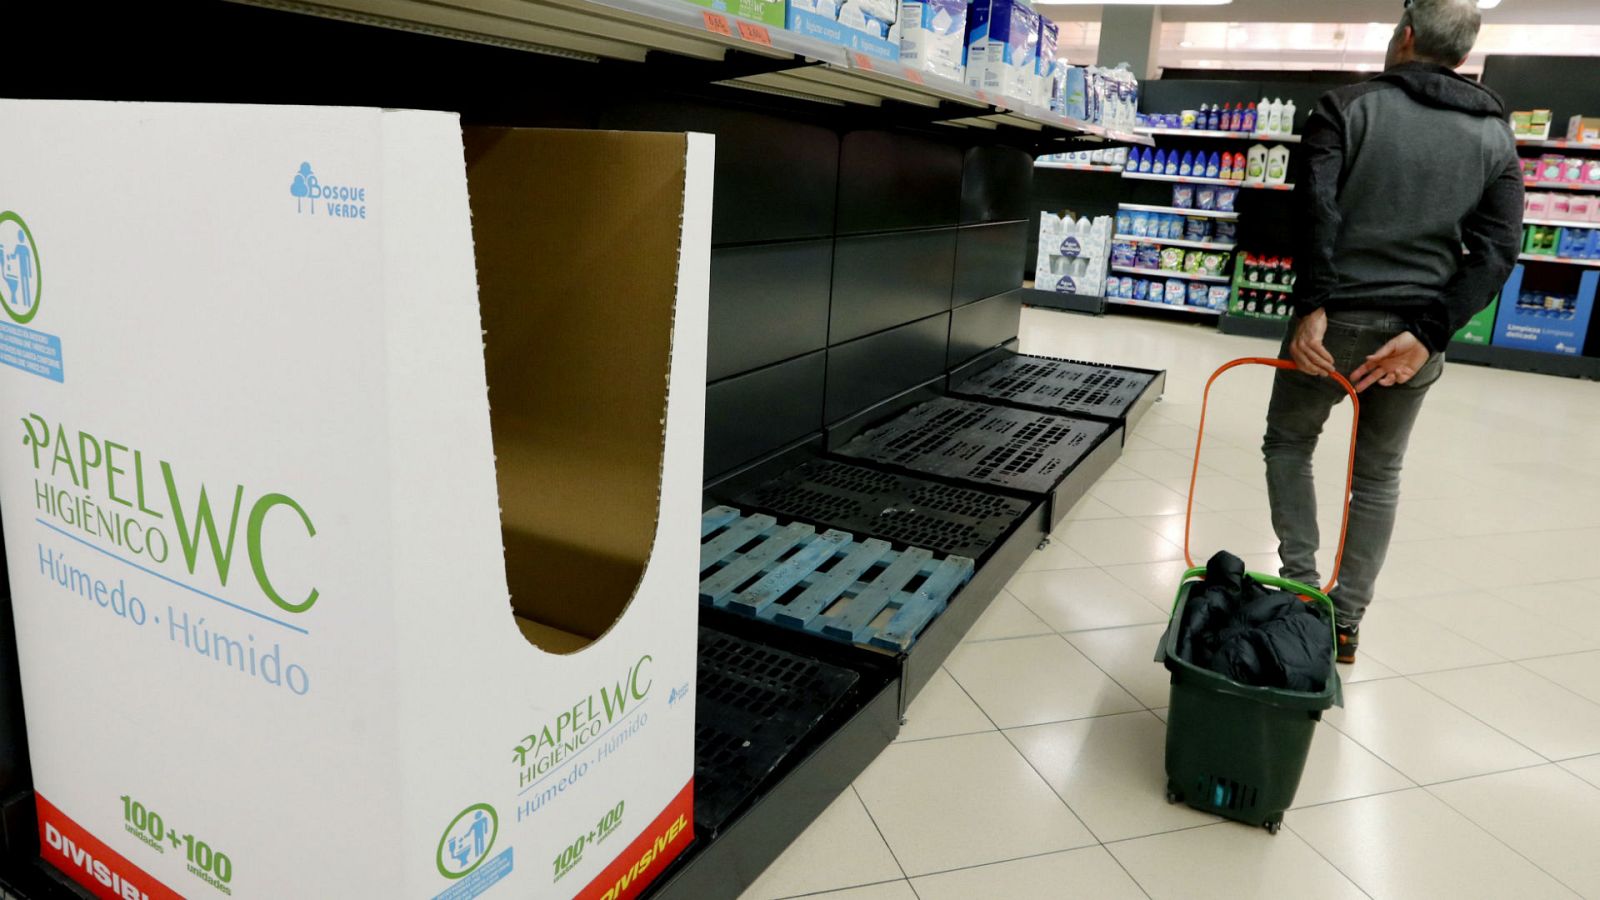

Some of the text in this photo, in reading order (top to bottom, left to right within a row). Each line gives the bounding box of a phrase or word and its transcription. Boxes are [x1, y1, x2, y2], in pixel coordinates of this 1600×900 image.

[308, 175, 366, 202] BOSQUE
[326, 202, 367, 220] VERDE
[21, 412, 320, 614] PAPEL WC
[38, 543, 310, 696] Húmedo Húmido
[511, 654, 653, 767] PAPEL WC
[517, 711, 649, 823] Húmedo Húmido
